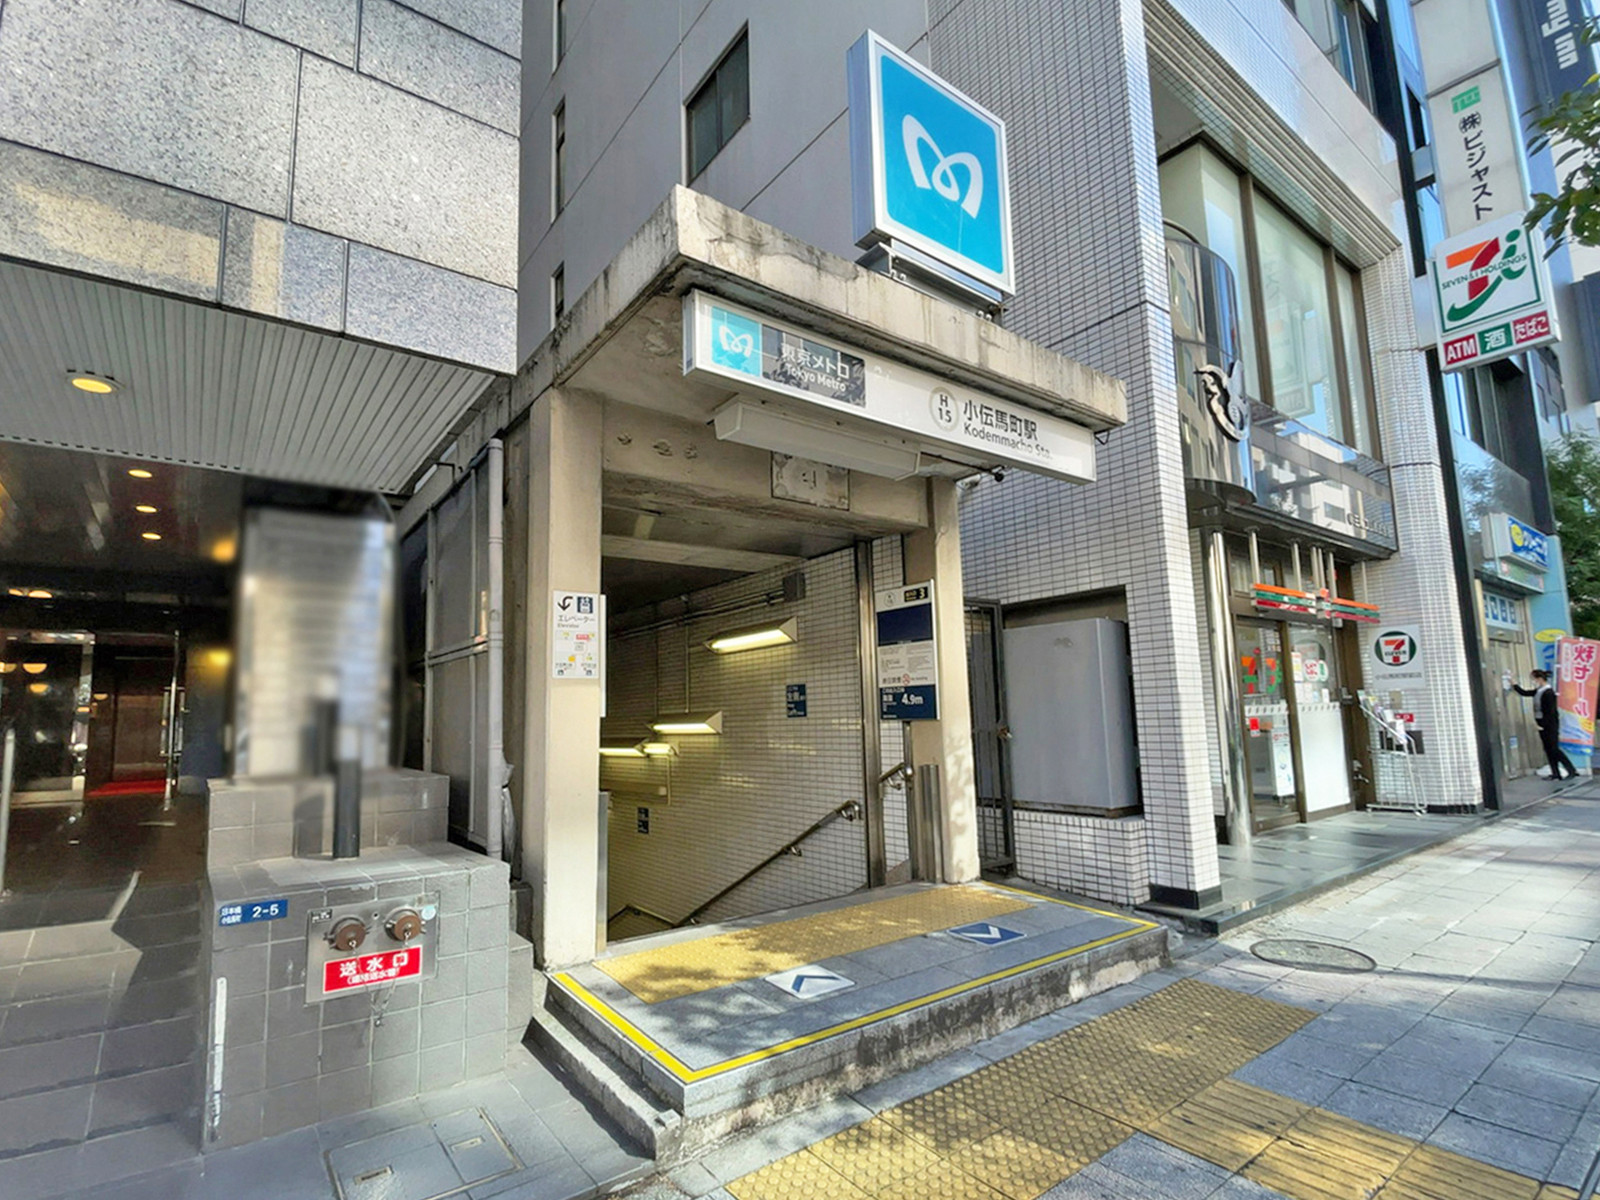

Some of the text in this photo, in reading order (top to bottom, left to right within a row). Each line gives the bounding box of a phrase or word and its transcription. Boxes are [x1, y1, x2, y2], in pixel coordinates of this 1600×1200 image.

[1442, 275, 1468, 290] SEVEN
[1480, 253, 1527, 277] HOLDINGS
[1484, 328, 1506, 350] 酒
[1515, 316, 1549, 339] たばこ
[781, 342, 850, 379] 東京メトロ
[1446, 338, 1476, 361] ATM
[785, 363, 846, 392] Tokyo Metro
[939, 393, 949, 408] H
[938, 407, 952, 423] 15
[963, 399, 1038, 441] 小伝馬町駅
[963, 421, 1053, 460] Kodemmacho Sta.
[918, 587, 926, 600] 3
[901, 693, 924, 705] 4.9m
[252, 903, 279, 918] 2-5
[340, 953, 408, 978] 送水口
